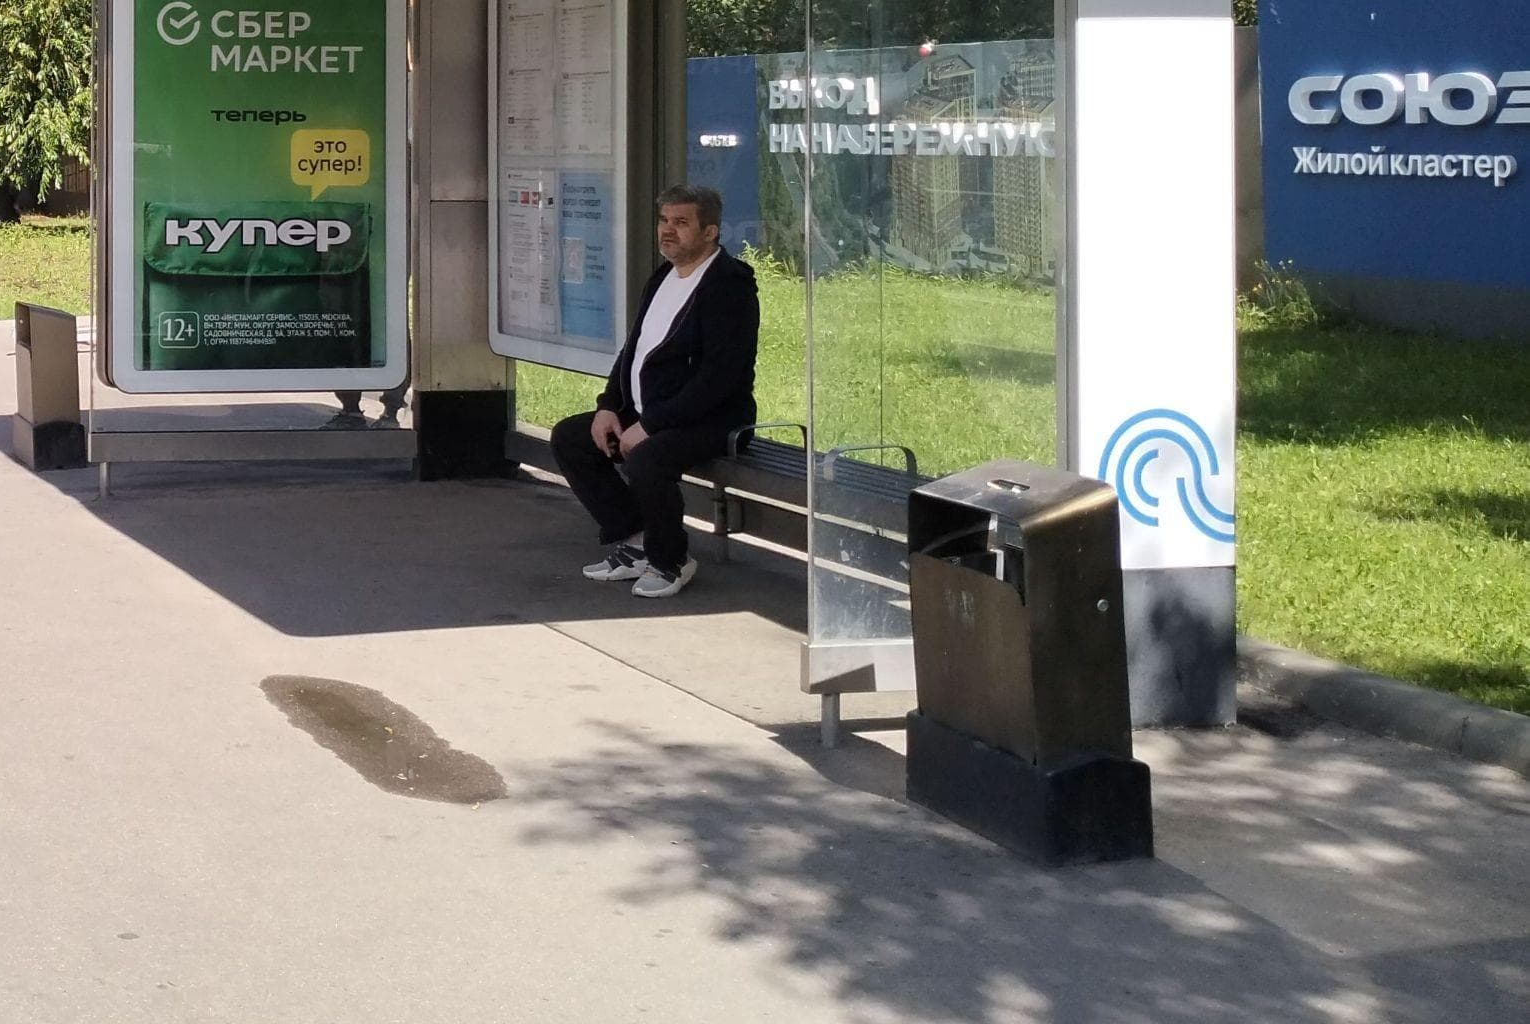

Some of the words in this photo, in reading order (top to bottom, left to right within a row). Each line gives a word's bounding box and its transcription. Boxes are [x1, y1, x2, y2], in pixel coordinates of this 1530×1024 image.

[211, 10, 311, 38] СБЕР
[210, 44, 363, 73] МАРКЕТ
[211, 109, 306, 125] теперь
[313, 141, 347, 153] это
[297, 156, 363, 174] супер!
[1293, 145, 1386, 176] Жилой
[1390, 153, 1517, 187] кластер
[165, 218, 352, 253] купер
[162, 318, 195, 341] 12+
